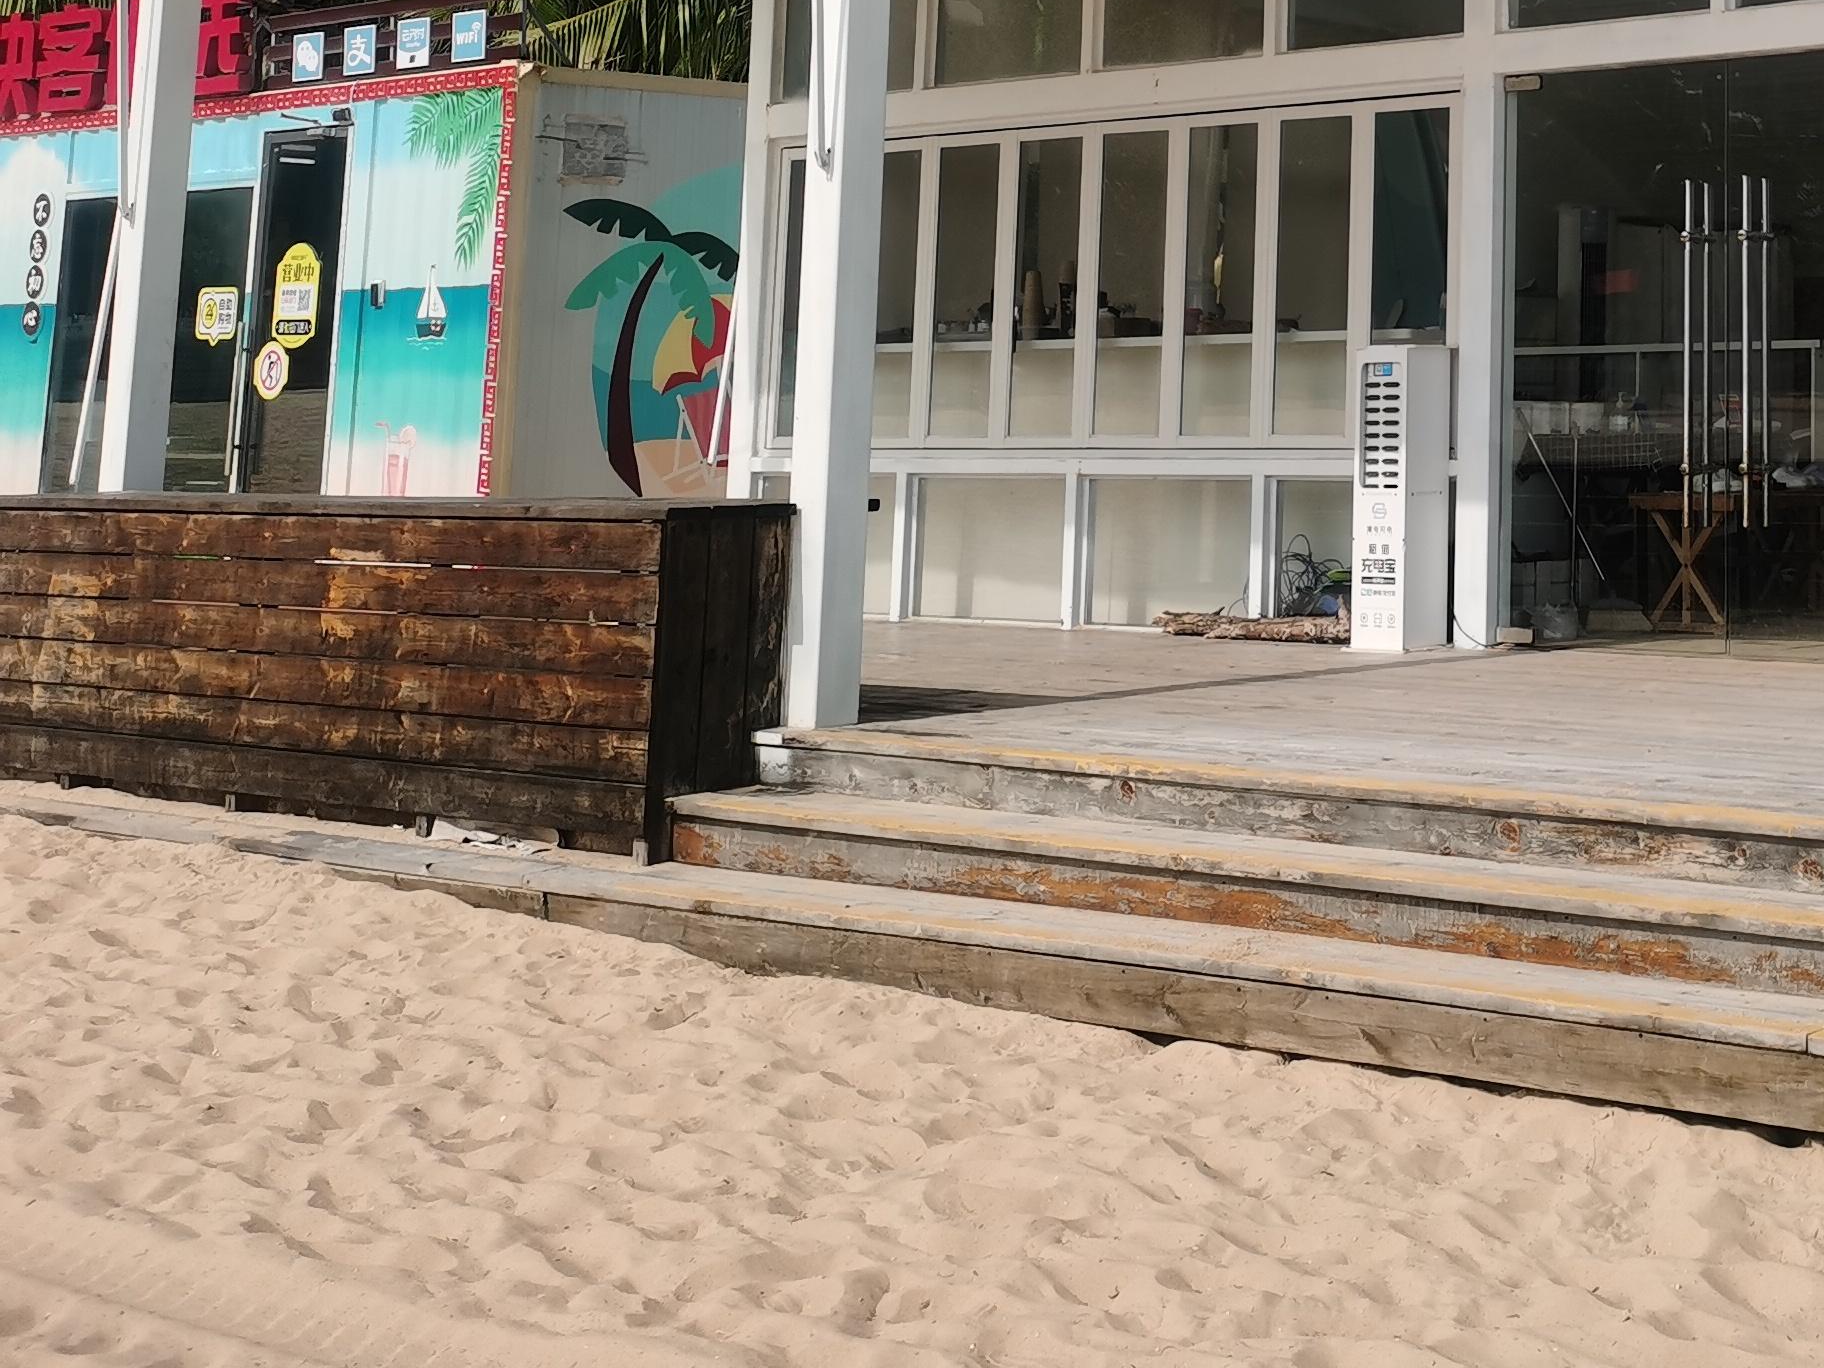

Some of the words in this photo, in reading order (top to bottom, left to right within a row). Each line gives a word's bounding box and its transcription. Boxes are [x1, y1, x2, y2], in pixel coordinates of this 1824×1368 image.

[282, 262, 315, 282] 营业中
[1361, 558, 1396, 573] 充电宝
